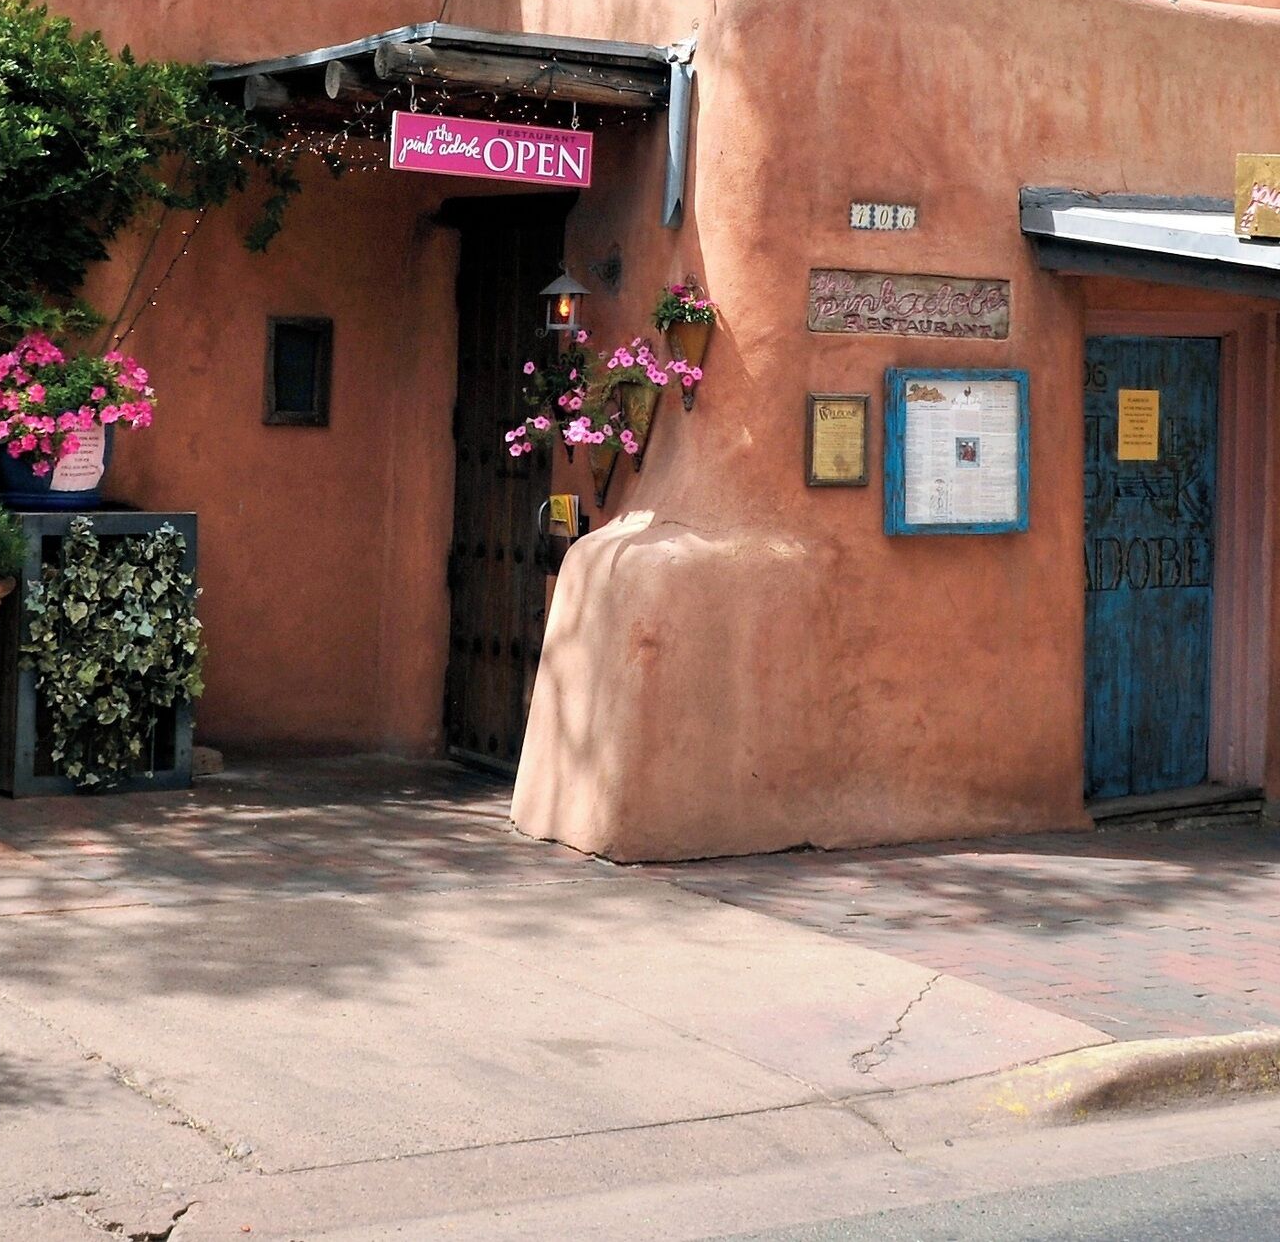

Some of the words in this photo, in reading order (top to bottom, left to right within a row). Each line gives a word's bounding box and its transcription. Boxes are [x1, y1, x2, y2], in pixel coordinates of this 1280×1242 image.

[433, 124, 453, 141] the
[497, 129, 577, 144] RESTAURANT
[398, 131, 434, 163] pink
[439, 134, 482, 158] adobe
[483, 137, 587, 180] OPEN
[856, 207, 912, 228] 106
[814, 277, 896, 321] pink
[894, 283, 1007, 317] adobe
